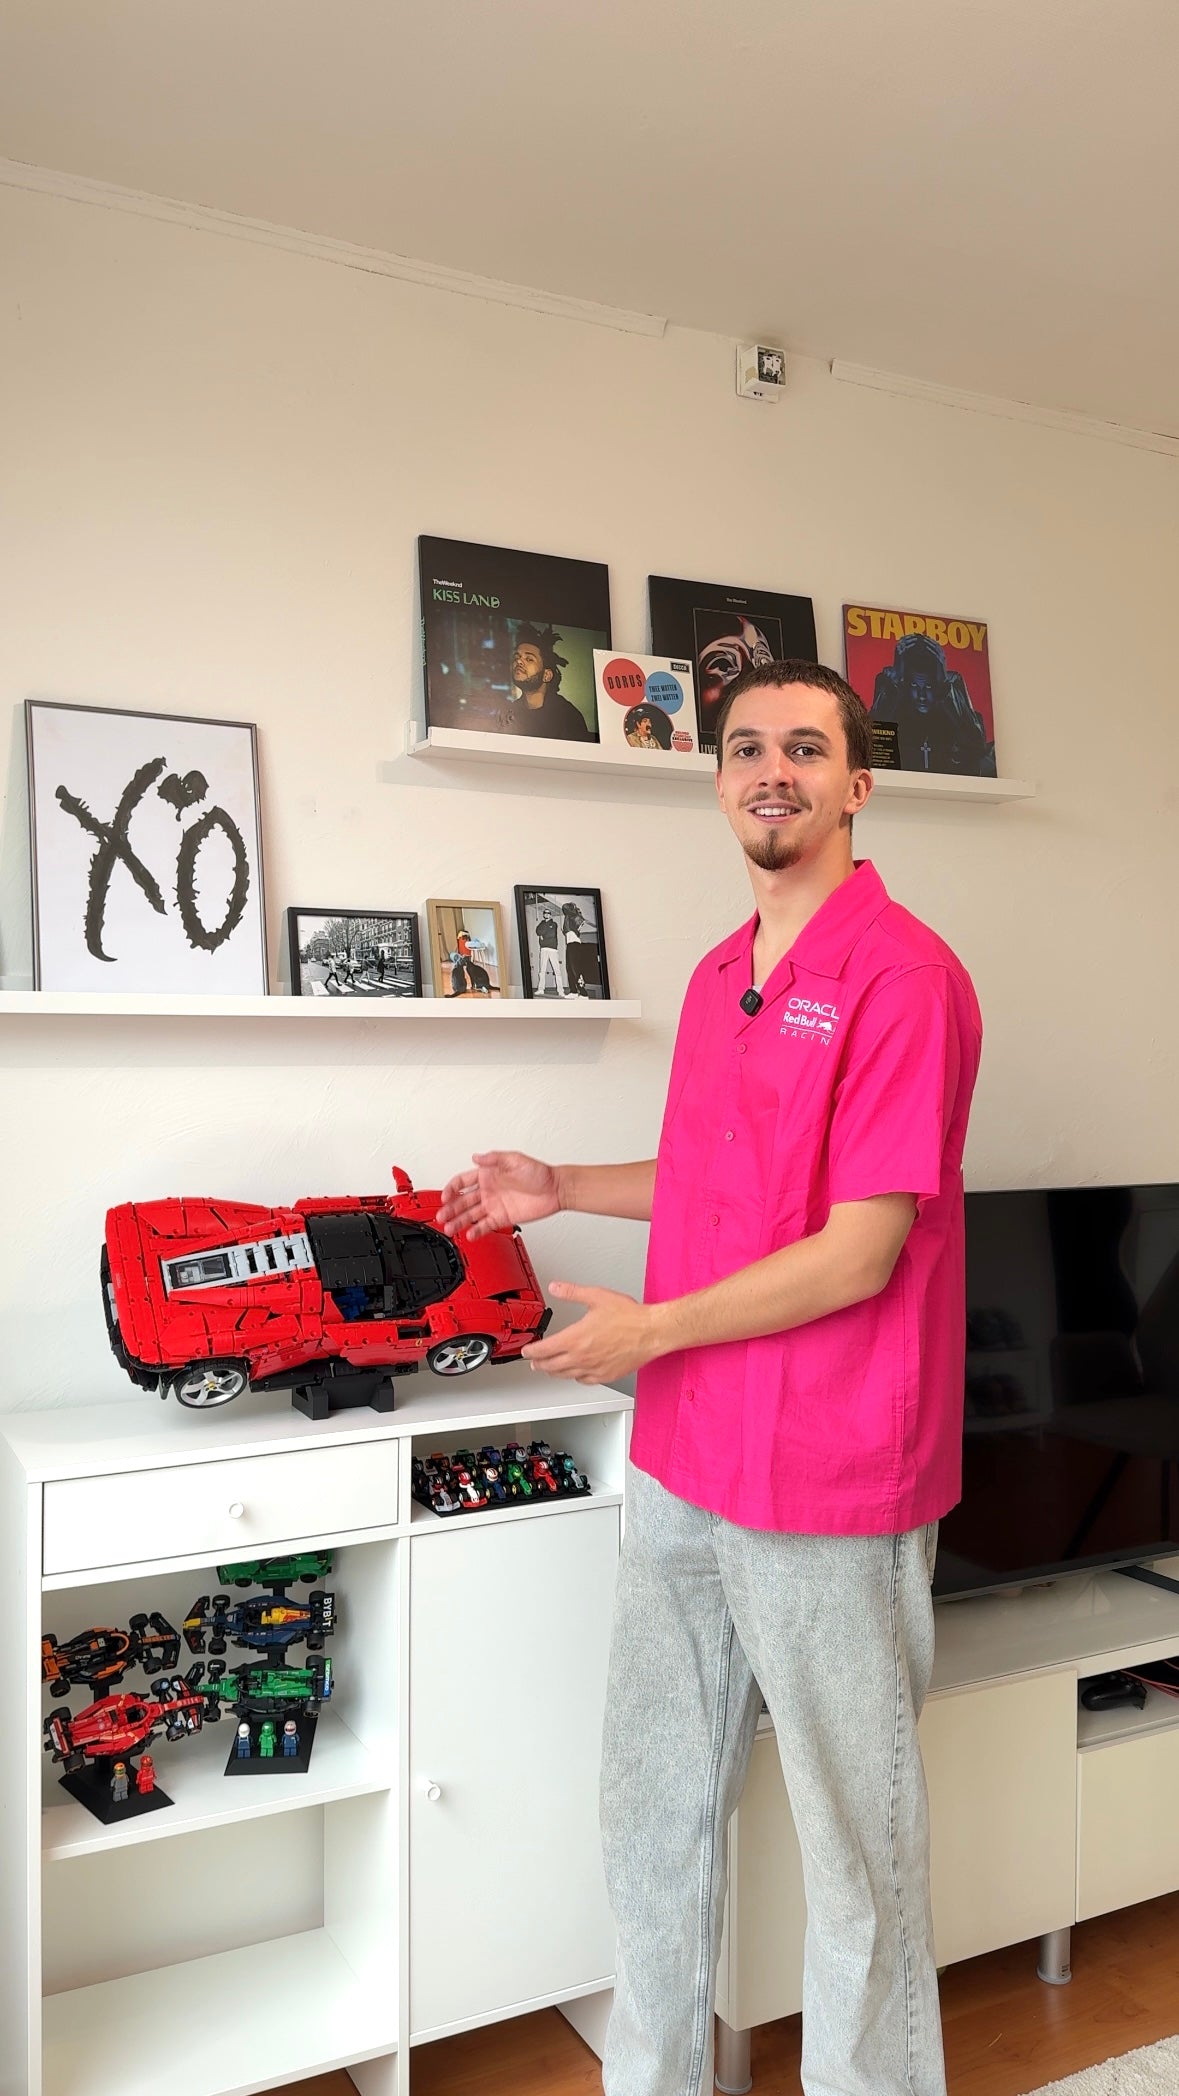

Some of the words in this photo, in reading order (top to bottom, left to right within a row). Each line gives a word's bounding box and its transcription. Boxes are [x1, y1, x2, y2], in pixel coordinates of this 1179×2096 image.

[432, 588, 460, 604] KISS
[463, 592, 500, 609] LAND
[607, 674, 643, 690] DORUS
[322, 1597, 334, 1627] BYBIT
